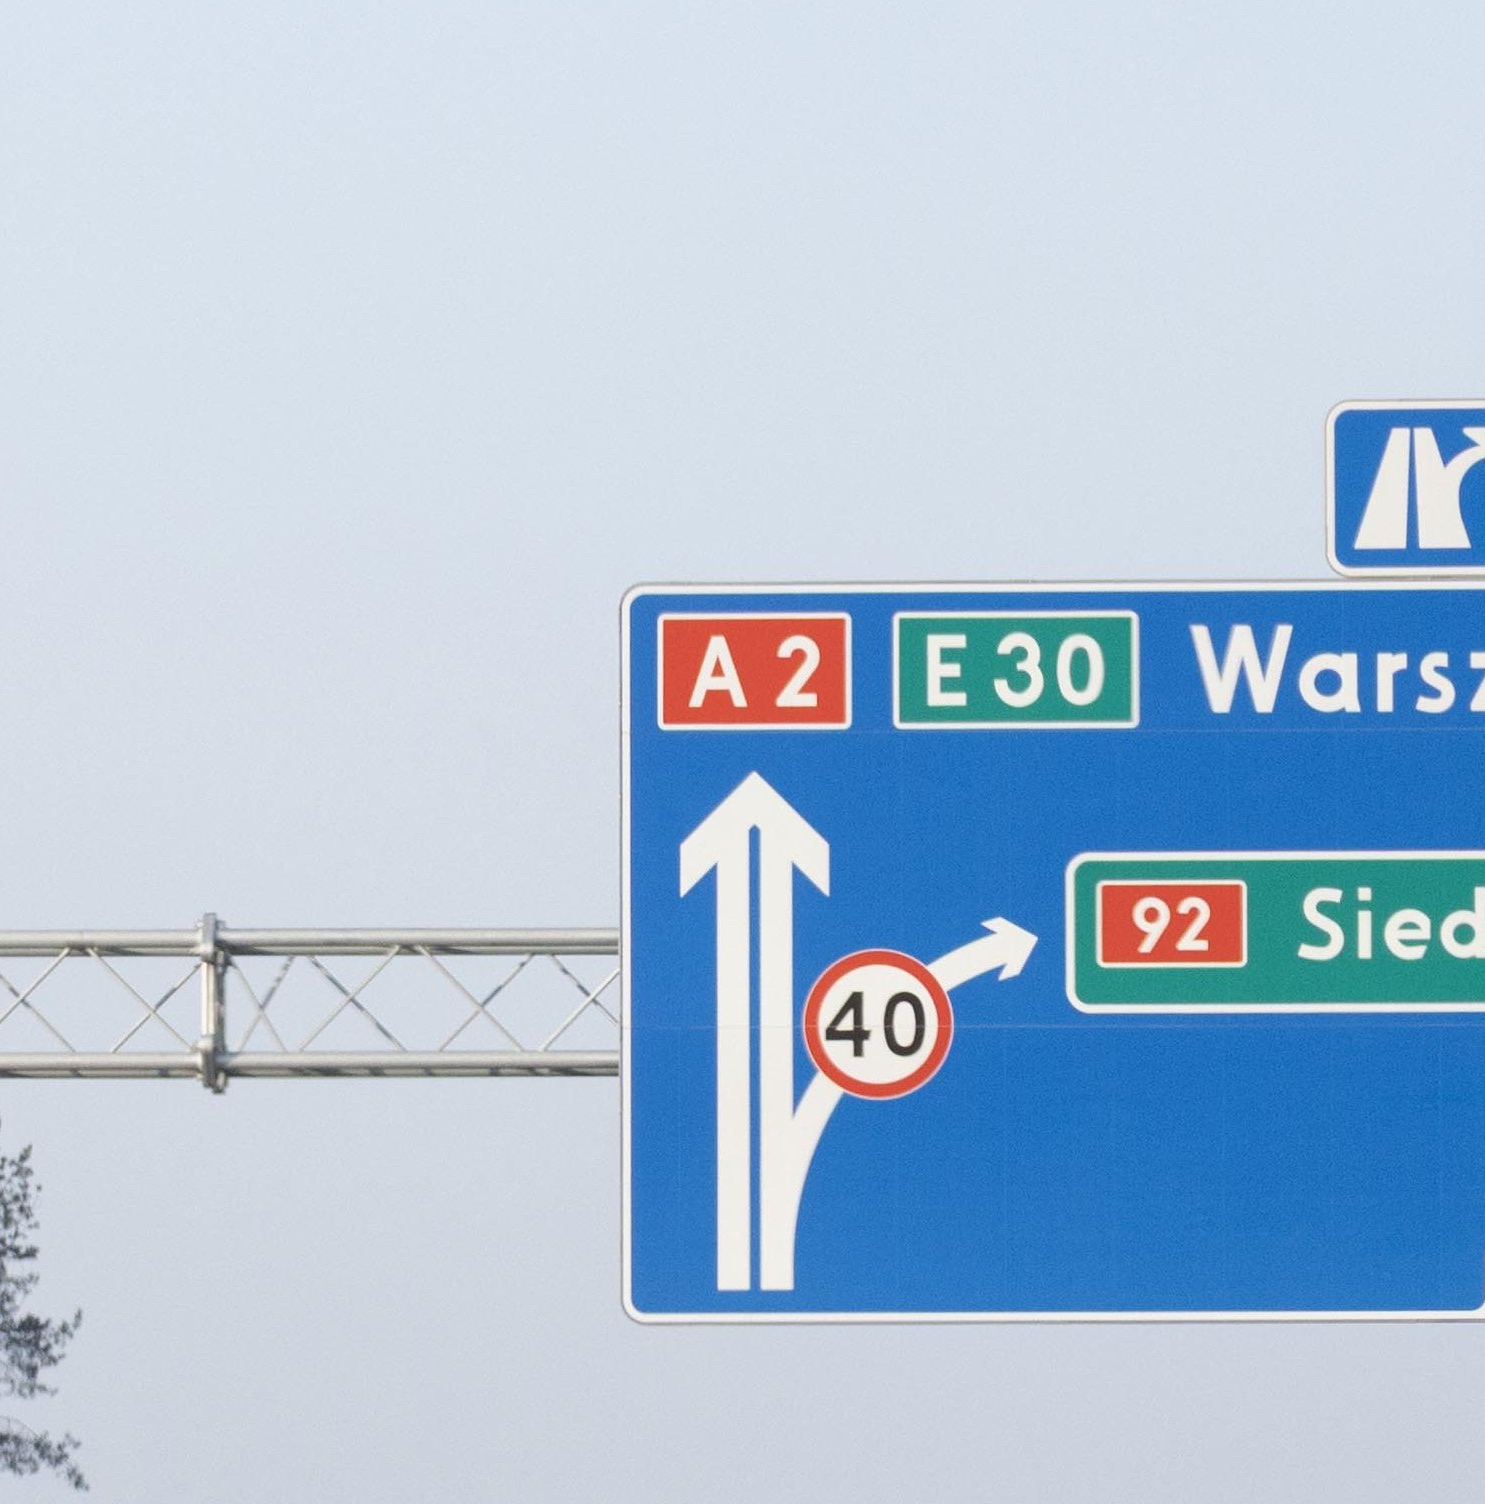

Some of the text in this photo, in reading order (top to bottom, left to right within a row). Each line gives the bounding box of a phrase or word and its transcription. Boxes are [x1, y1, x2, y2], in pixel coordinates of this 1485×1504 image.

[689, 634, 822, 708] A 2
[927, 633, 1106, 707] E 30
[1132, 896, 1211, 954] 92
[824, 991, 928, 1059] 40
